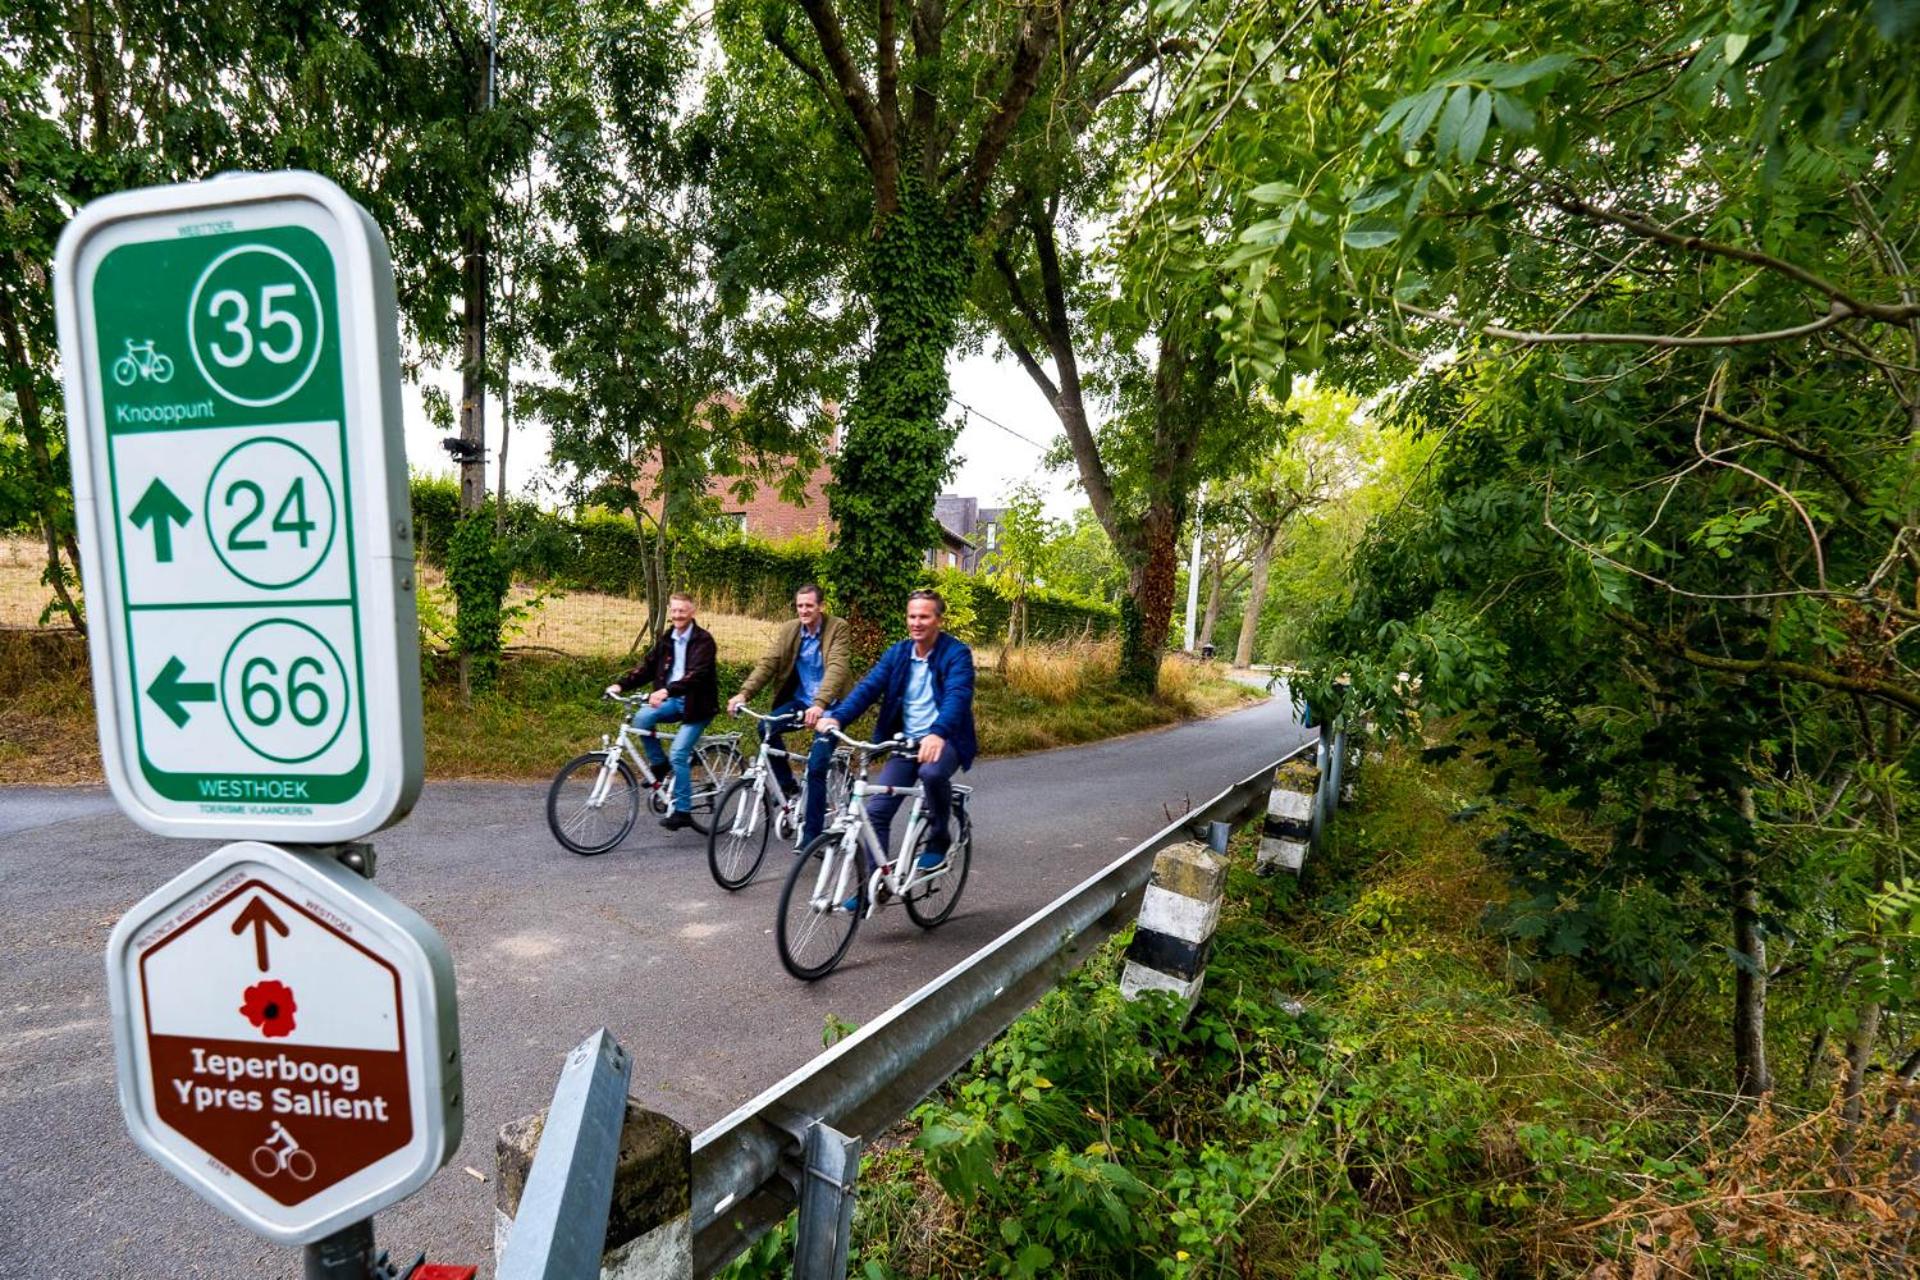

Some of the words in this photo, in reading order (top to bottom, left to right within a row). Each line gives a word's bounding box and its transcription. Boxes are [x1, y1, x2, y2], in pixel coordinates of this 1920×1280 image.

[208, 283, 303, 368] 35
[116, 400, 215, 424] Knooppunt
[224, 475, 317, 551] 24
[240, 656, 330, 727] 66
[199, 780, 310, 798] WESTHOEK
[306, 899, 353, 933] WESTTOER
[190, 1048, 360, 1091] Ieperboog
[173, 1079, 263, 1111] Ypres
[272, 1089, 389, 1122] Salient
